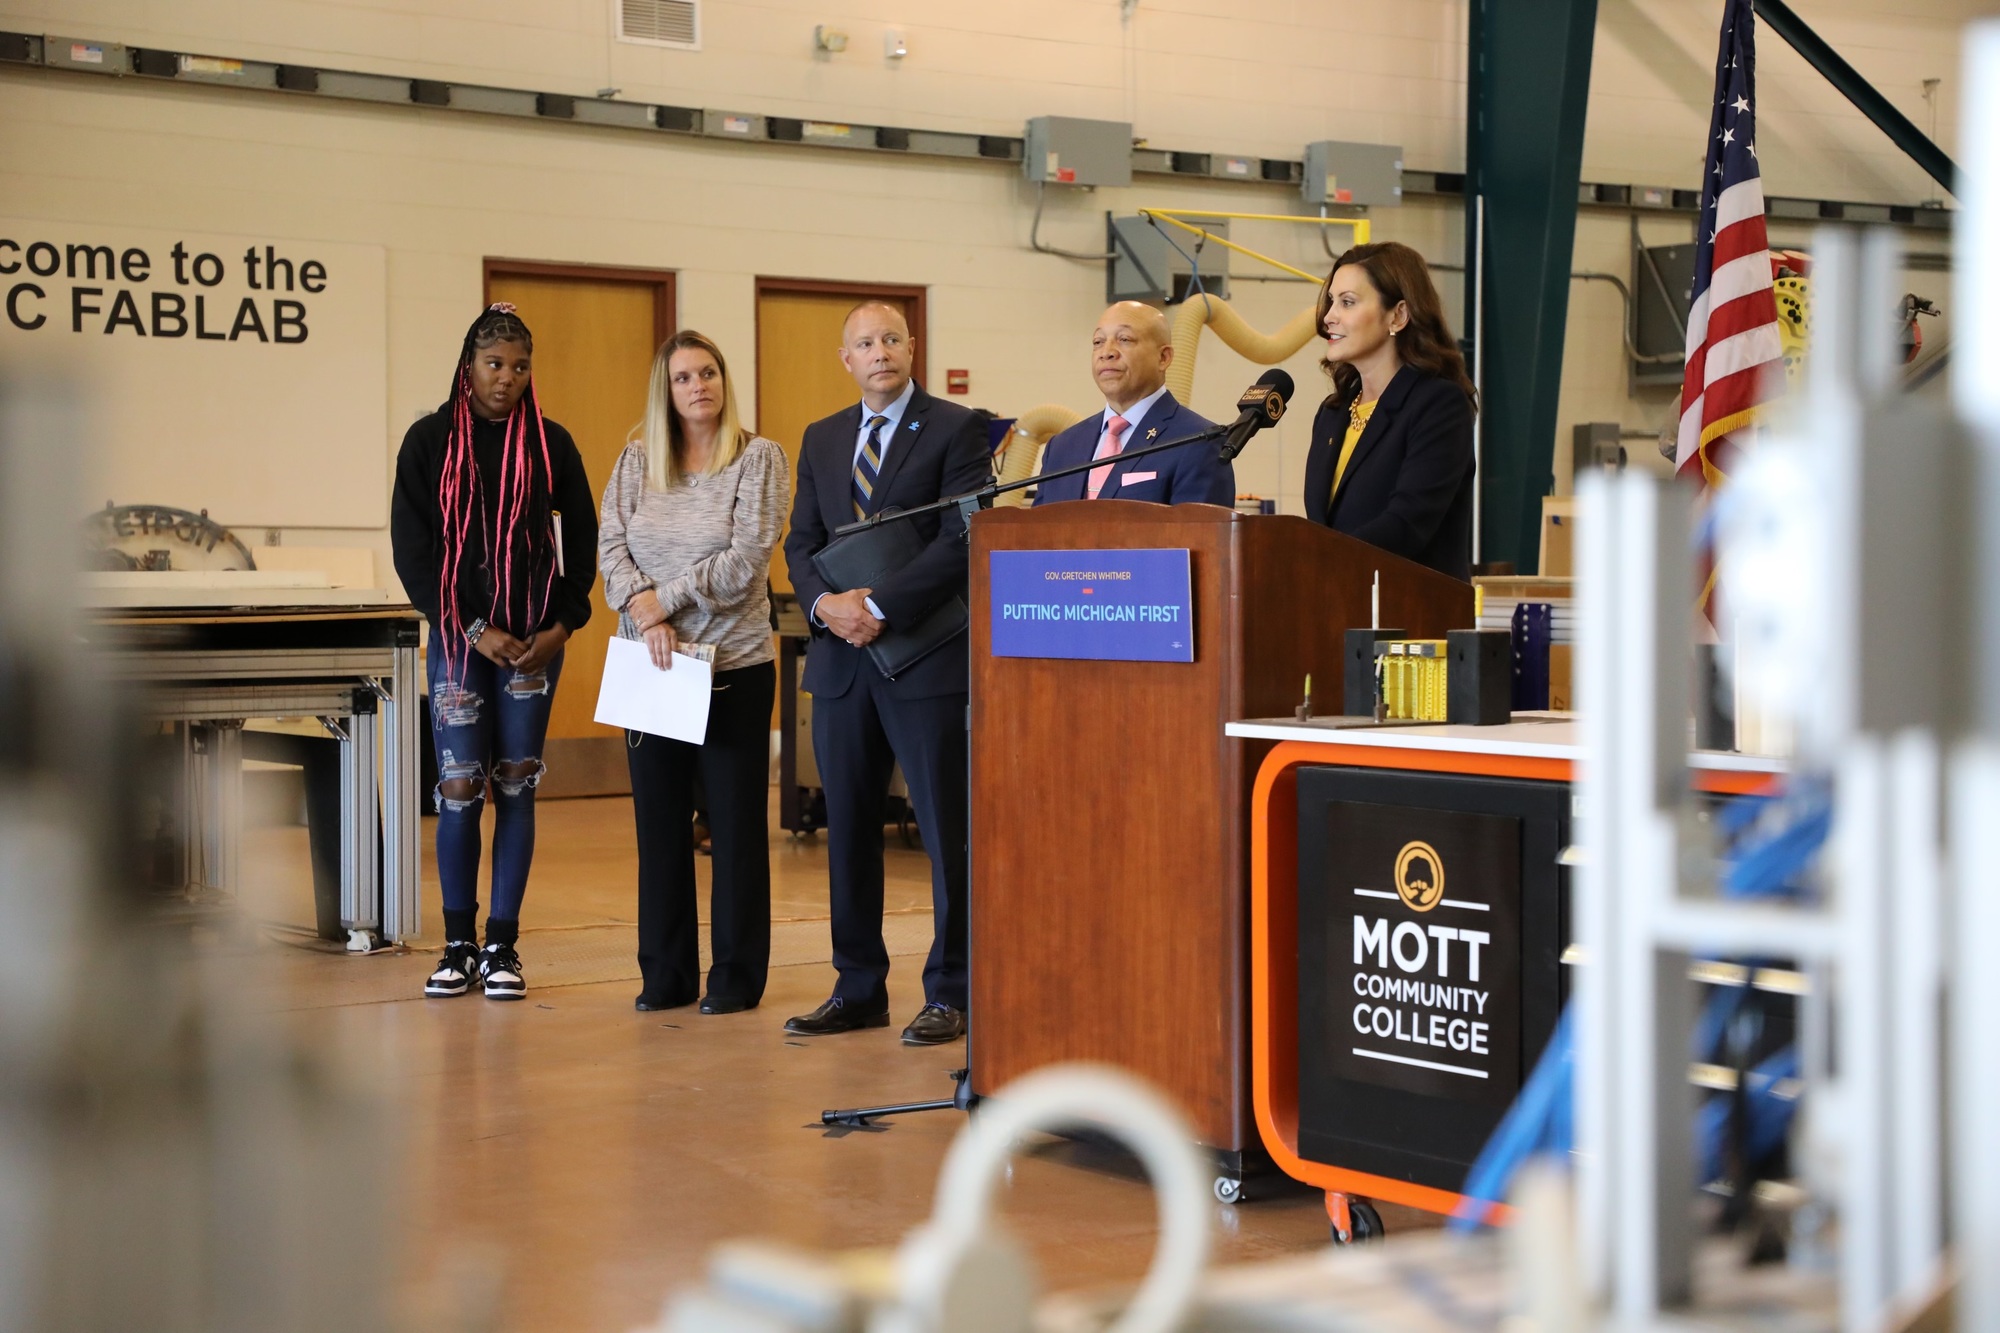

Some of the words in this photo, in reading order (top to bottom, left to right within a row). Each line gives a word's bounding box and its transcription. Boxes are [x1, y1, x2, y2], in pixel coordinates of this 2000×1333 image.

[170, 240, 225, 288] to
[243, 244, 327, 294] the
[71, 285, 309, 344] FABLAB
[102, 509, 226, 553] ETROIT
[1044, 571, 1061, 581] GOV.
[1061, 571, 1098, 581] GRETCHEN
[1098, 571, 1132, 581] WHITMER
[1003, 603, 1061, 621] PUTTING
[1064, 604, 1136, 622] MICHIGAN
[1139, 605, 1180, 623] FIRST
[1353, 915, 1490, 983] MOTT
[1353, 972, 1489, 1015] COMMUNITY
[1352, 1002, 1490, 1055] COLLEGE
